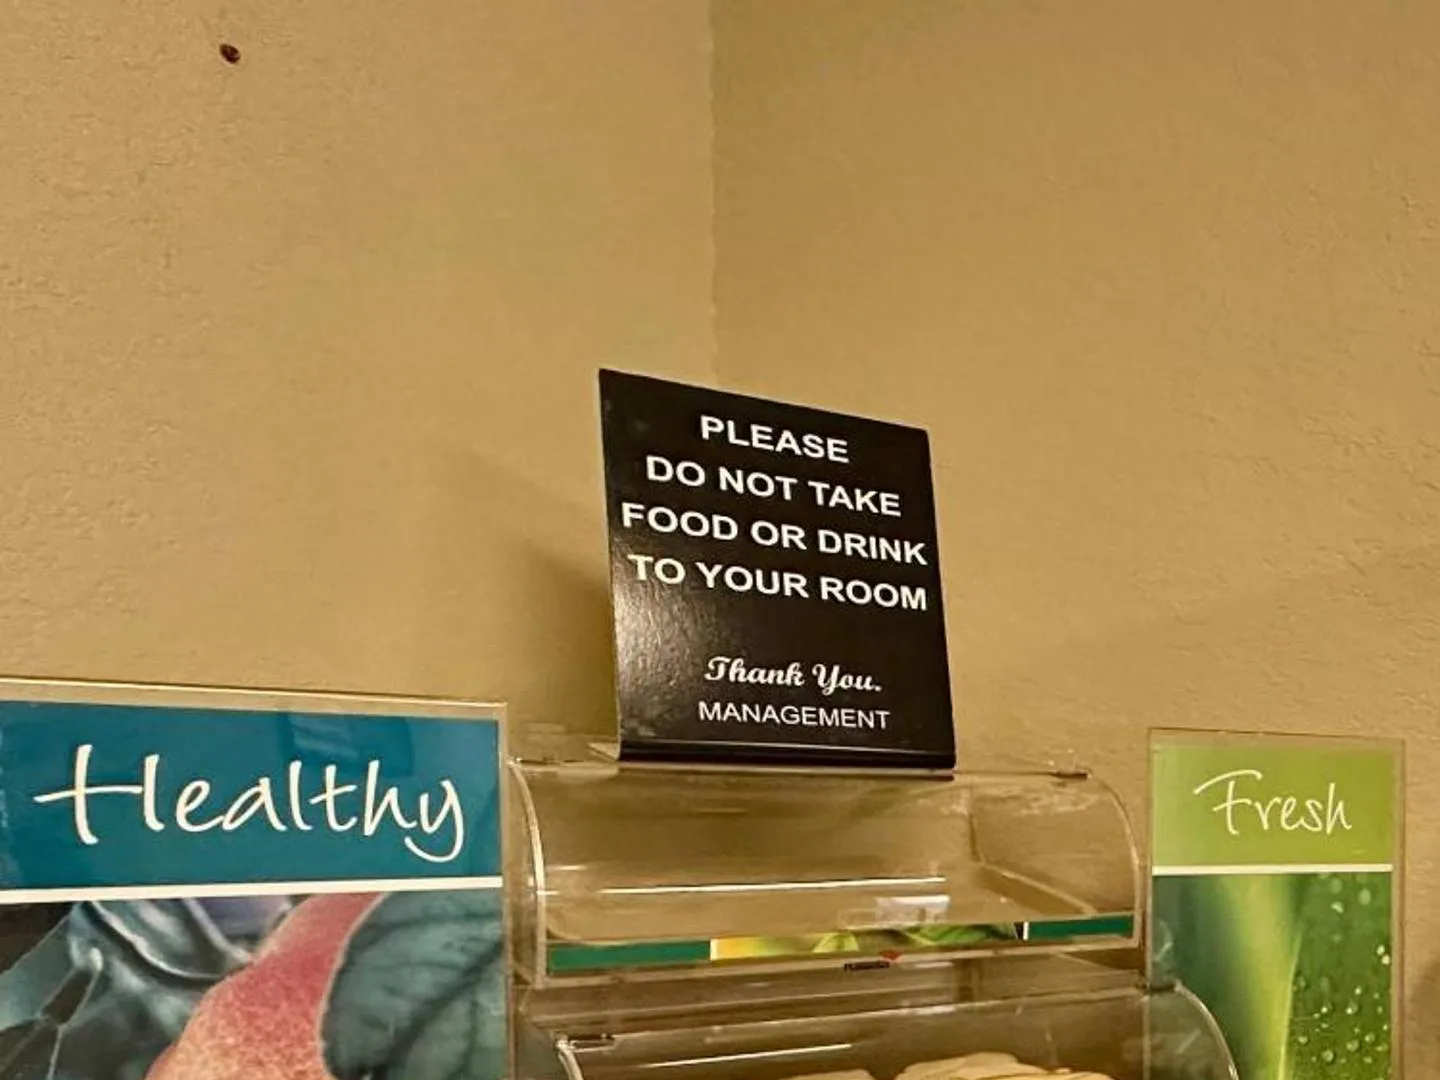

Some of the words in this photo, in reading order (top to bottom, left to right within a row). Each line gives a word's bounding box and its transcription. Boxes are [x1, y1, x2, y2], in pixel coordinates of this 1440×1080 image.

[700, 415, 850, 464] PLEASE
[645, 455, 706, 488] DO
[718, 466, 797, 500] NOT
[808, 480, 902, 517] TAKE
[621, 502, 738, 541] FOOD
[750, 520, 807, 550] OR
[817, 528, 929, 566] DRINK
[627, 554, 686, 585] TO
[696, 561, 809, 598] YOUR
[820, 576, 928, 611] ROOM
[704, 656, 805, 687] Thank
[698, 701, 890, 729] MANAGEMENT
[32, 744, 465, 863] Healthy
[1193, 769, 1352, 835] Fresh
